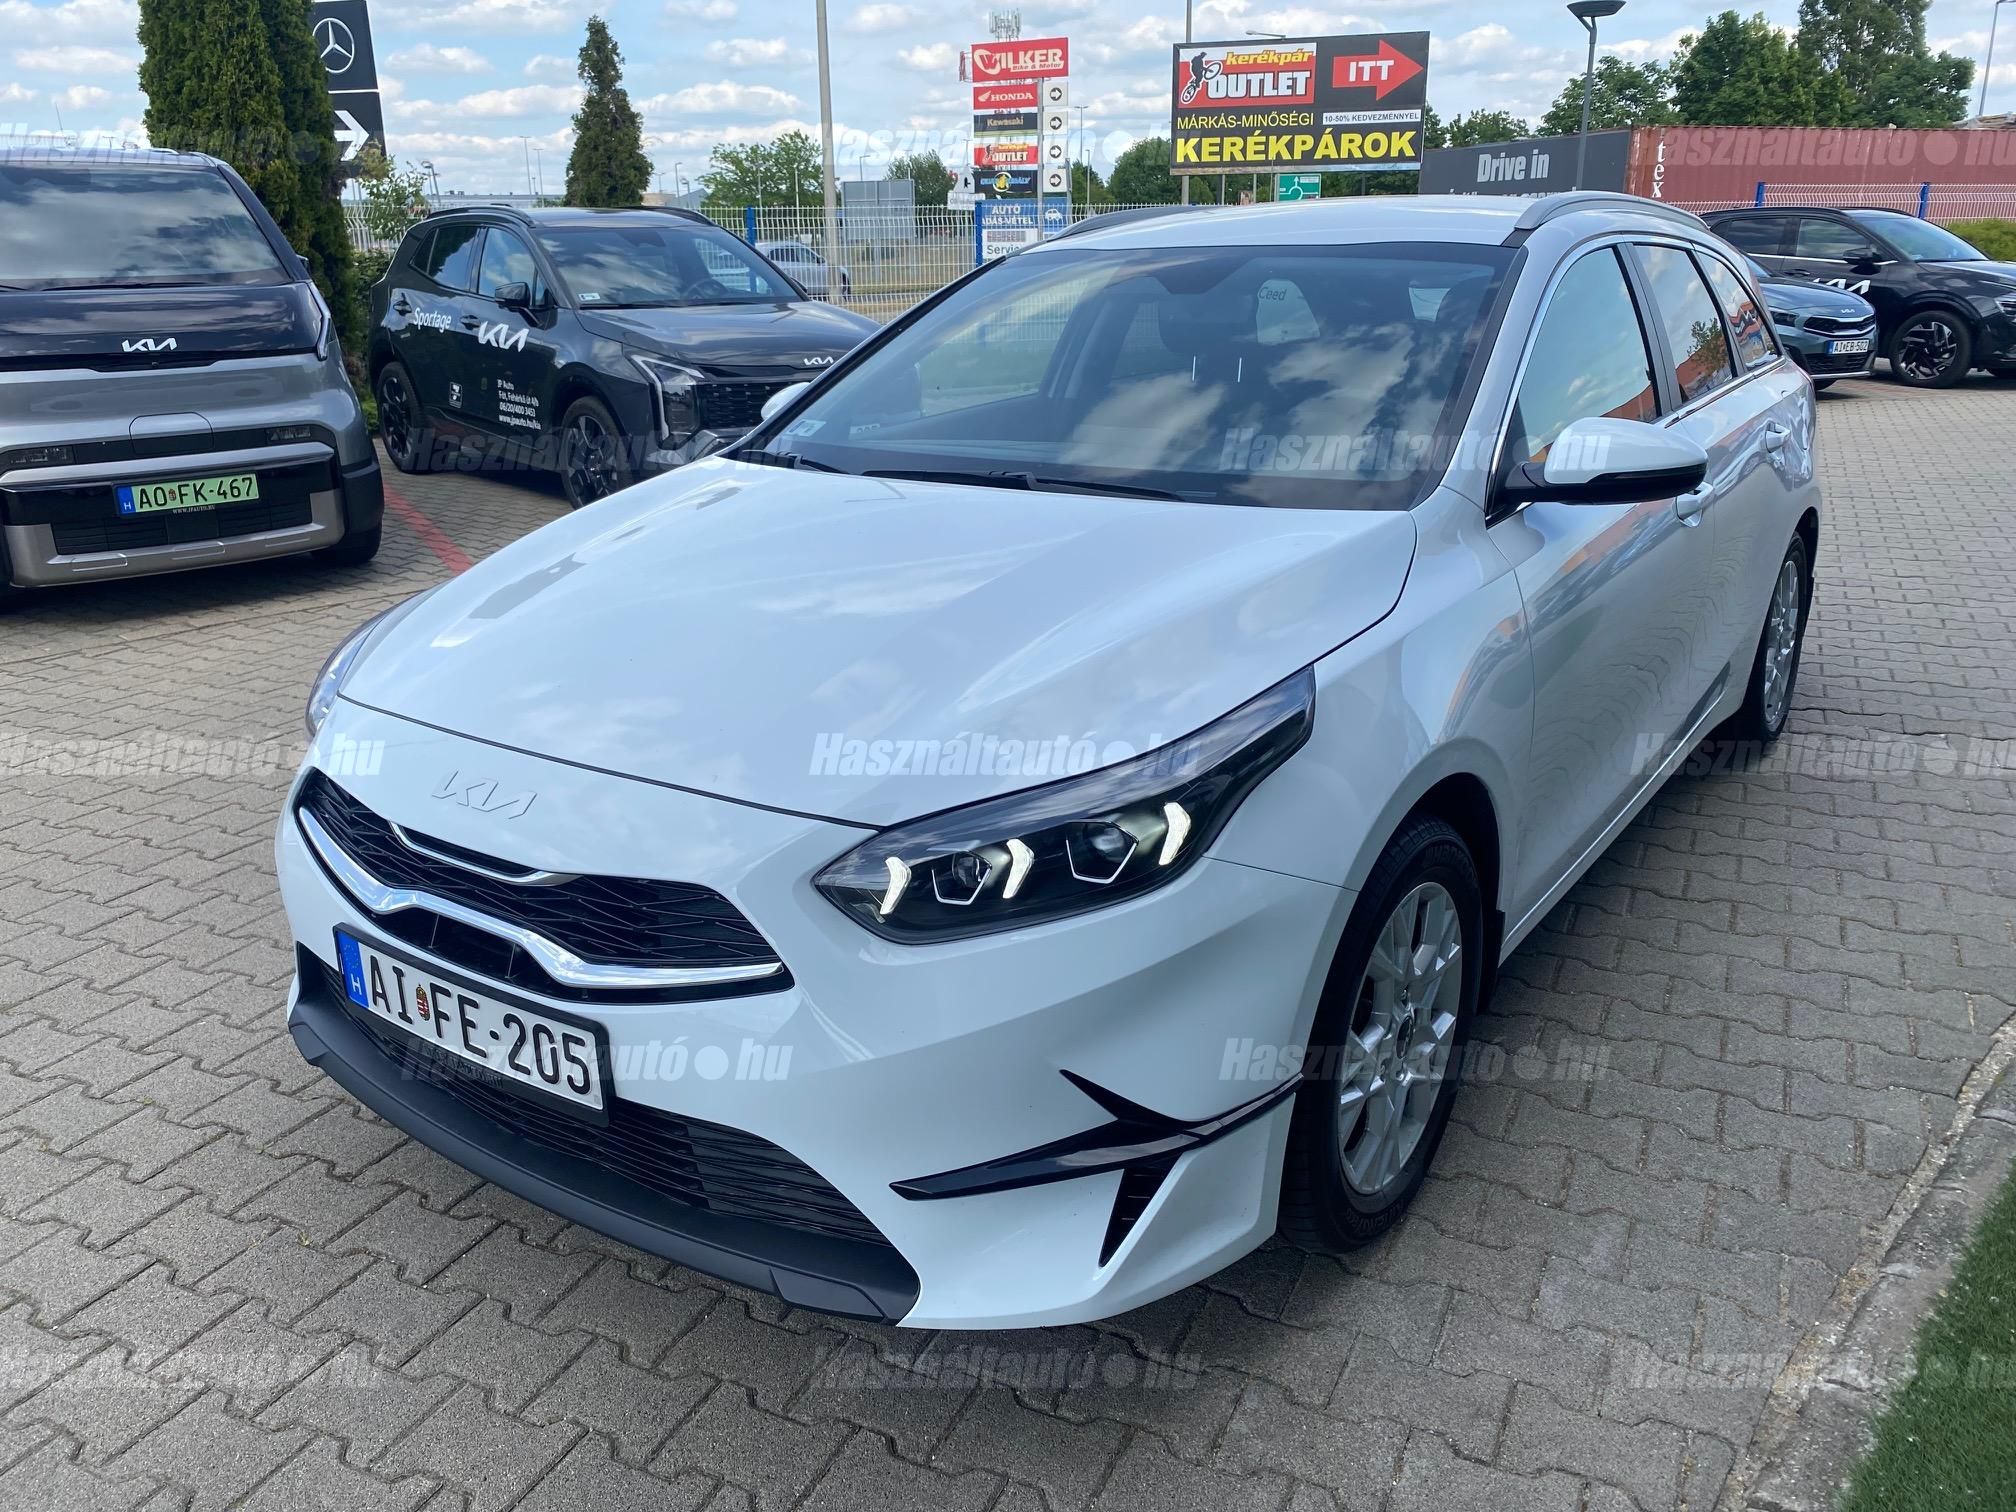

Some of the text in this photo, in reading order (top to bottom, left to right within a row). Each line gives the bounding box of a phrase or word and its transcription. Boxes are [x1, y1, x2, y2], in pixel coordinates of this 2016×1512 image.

[974, 48, 1063, 75] WILKER
[1225, 48, 1313, 66] kerékpár
[1348, 60, 1395, 82] ITT
[1207, 71, 1312, 99] OUTLET
[990, 93, 1034, 102] HONDA
[987, 116, 1024, 127] Kawasaki
[1177, 111, 1314, 129] MÁRKÁS-MINŐSÉGI
[1324, 112, 1420, 123] 10-50% KEDVEZMÉNNYEL
[1176, 128, 1417, 163] KERÉKPÁROK
[991, 152, 1028, 162] OUTLET
[1477, 149, 1550, 183] Drive in
[1259, 287, 1287, 301] Ceed
[413, 307, 452, 333] Sportage
[121, 337, 178, 352] KIA
[478, 321, 530, 352] KIA
[803, 356, 834, 366] KIA
[177, 477, 253, 504] FK-467
[123, 502, 132, 510] H
[431, 770, 538, 820] KIA
[351, 972, 364, 997] H
[369, 955, 413, 1025] AI
[430, 982, 592, 1096] FE-205
